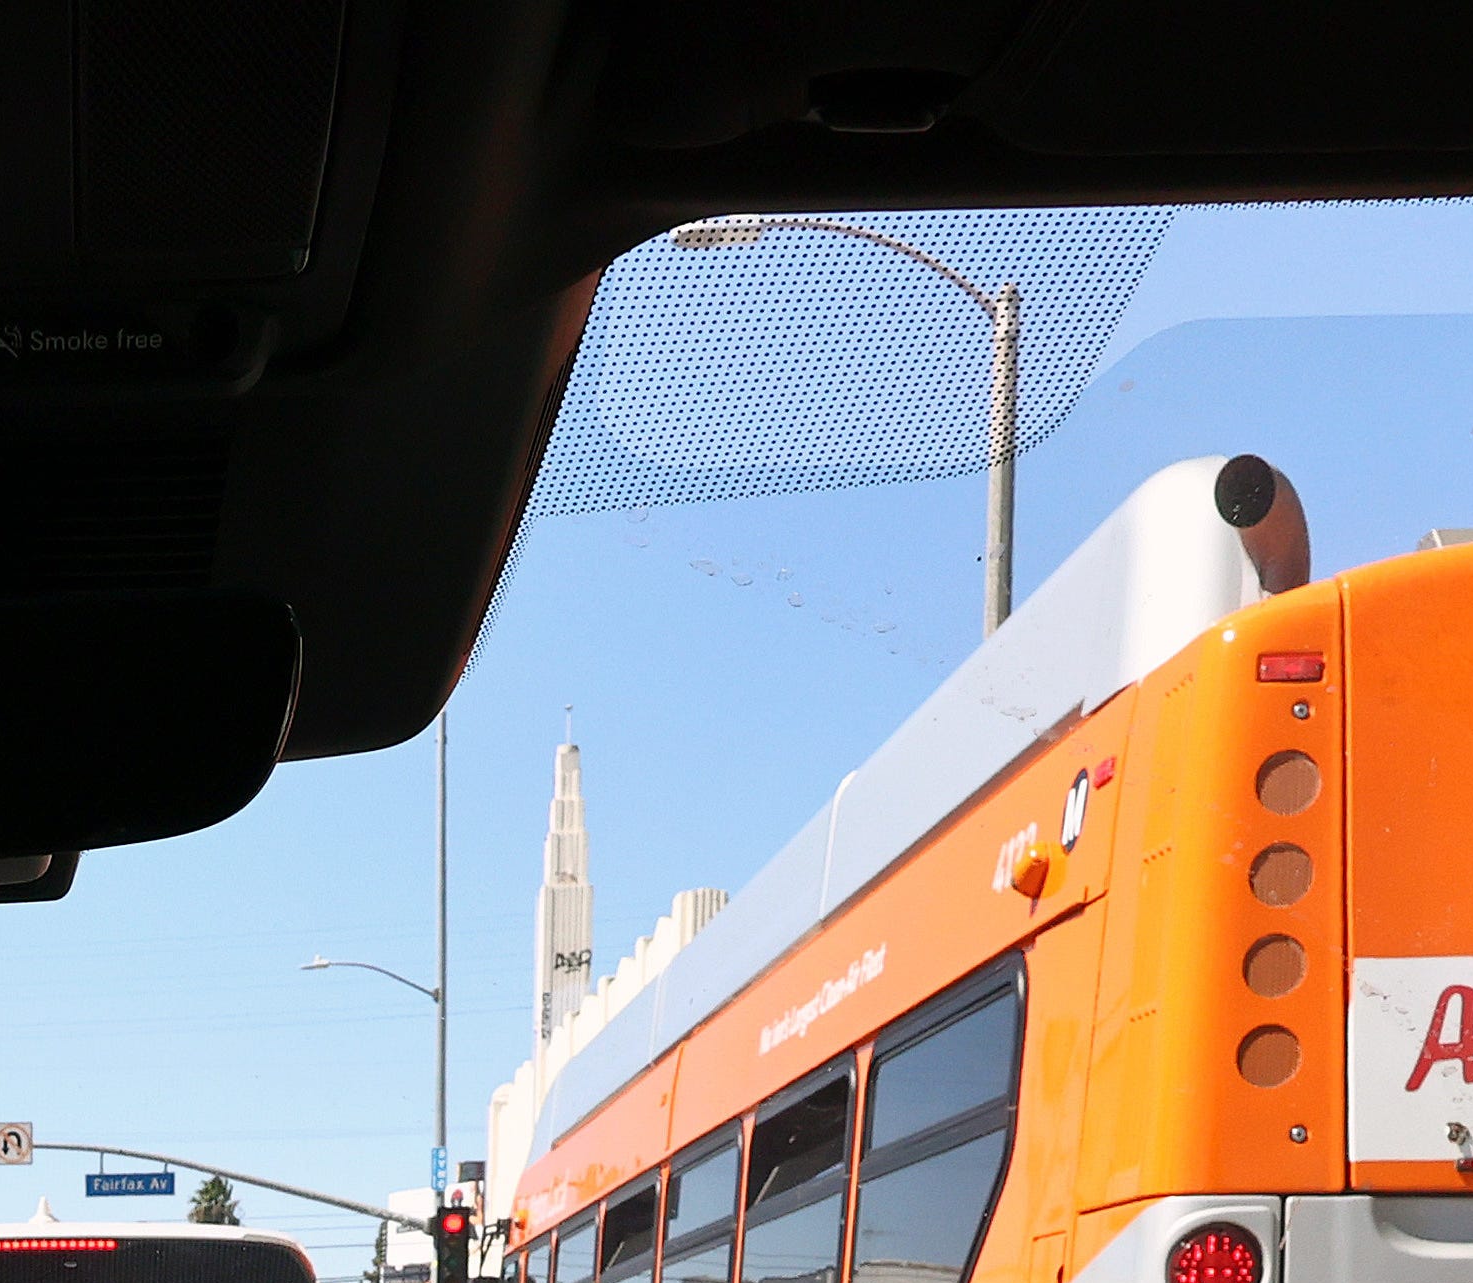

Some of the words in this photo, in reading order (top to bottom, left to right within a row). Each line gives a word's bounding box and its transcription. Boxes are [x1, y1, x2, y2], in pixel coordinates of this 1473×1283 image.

[30, 330, 109, 351] Smoke
[117, 328, 163, 349] free
[94, 1176, 144, 1192] Fairfax
[149, 1176, 169, 1191] Av
